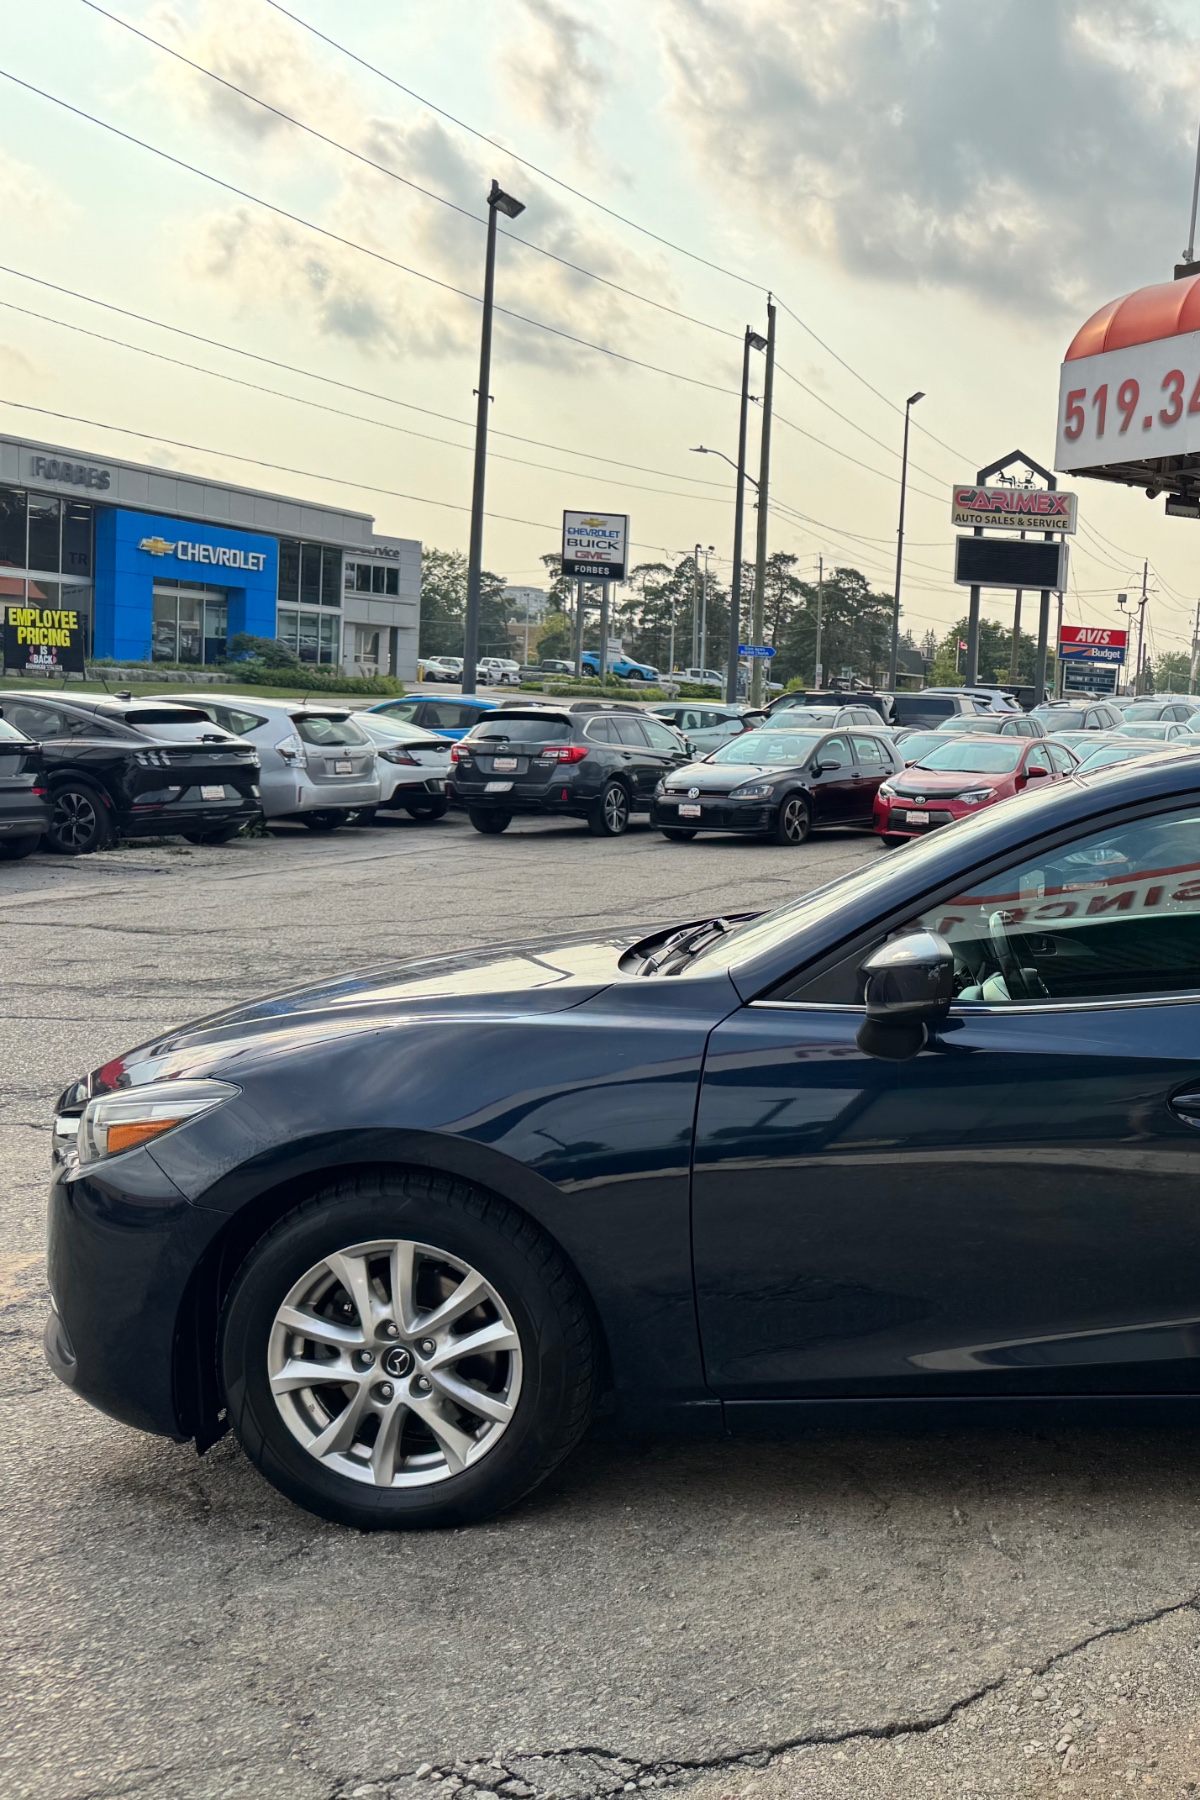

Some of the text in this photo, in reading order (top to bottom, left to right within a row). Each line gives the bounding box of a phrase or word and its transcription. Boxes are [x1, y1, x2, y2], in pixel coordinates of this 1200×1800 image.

[32, 456, 110, 489] FORBES
[955, 489, 1070, 515] CARIMEX
[955, 513, 1068, 529] AUTO SALES & SERVICE
[568, 527, 620, 538] CHEVROLET
[567, 538, 620, 550] BUICK
[177, 541, 266, 571] CHEVROLET
[575, 550, 611, 560] GMC
[575, 565, 610, 575] FORBES
[8, 607, 78, 629] EMPLOYEE
[17, 627, 71, 647] PRICING
[1075, 629, 1111, 644] AVIS
[40, 645, 48, 655] IS
[1092, 648, 1121, 660] Budget
[33, 654, 53, 664] BACK
